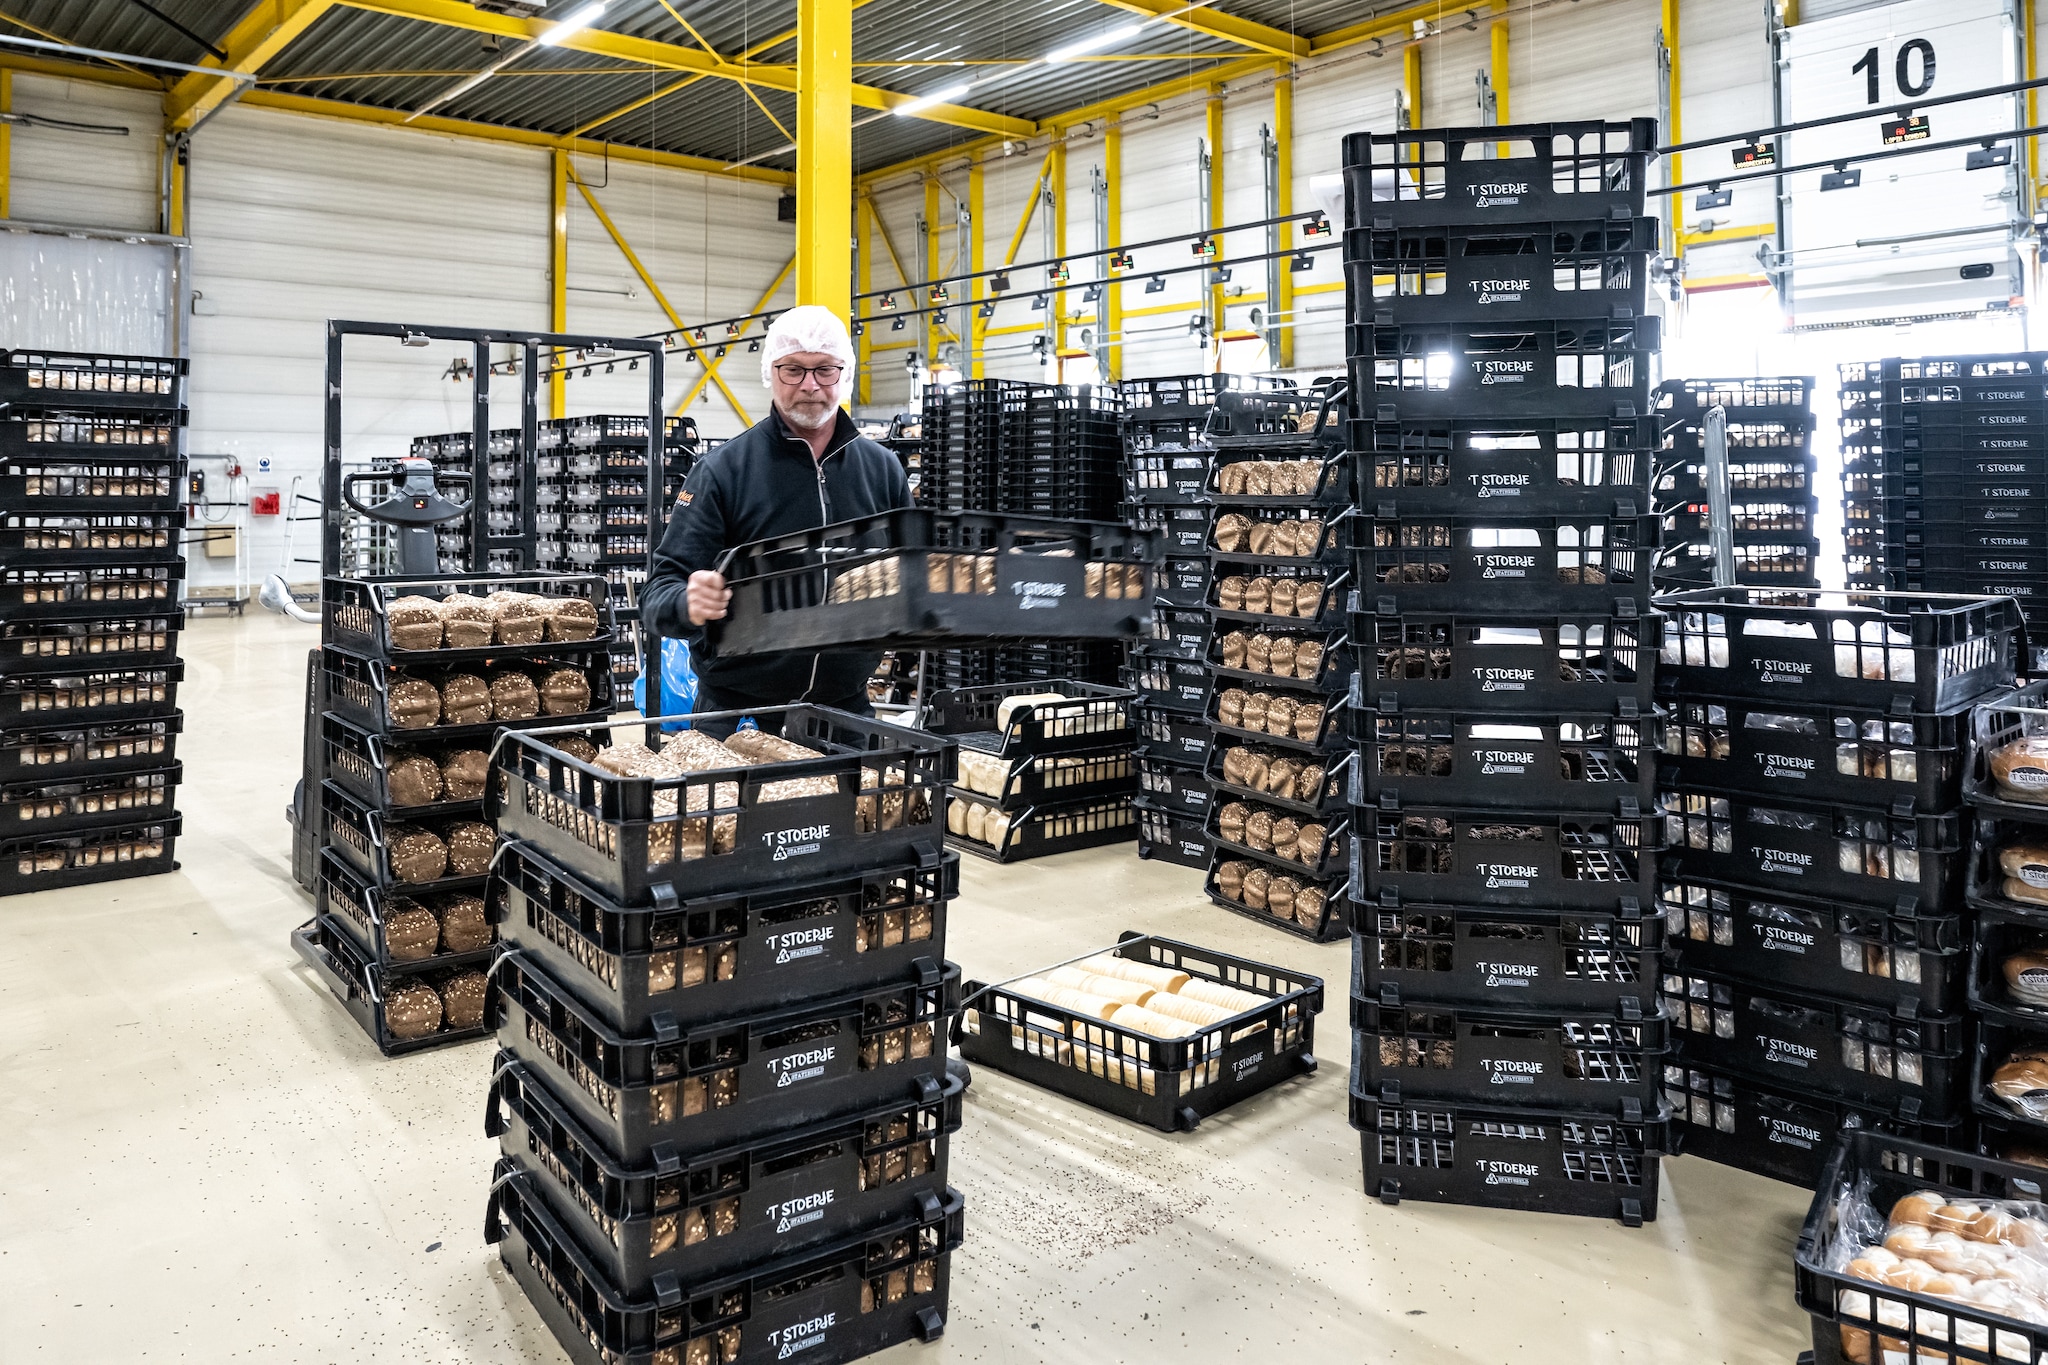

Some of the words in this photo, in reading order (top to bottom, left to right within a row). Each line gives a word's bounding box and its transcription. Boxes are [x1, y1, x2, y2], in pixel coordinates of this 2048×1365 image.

[1852, 38, 1936, 104] 10
[1480, 183, 1528, 195] STOEPJE
[1482, 279, 1531, 291] STOEPJE
[1485, 361, 1533, 372] STOEPJE
[1482, 474, 1530, 485] STOEPJE
[1487, 555, 1535, 567] STOEPJE
[1486, 668, 1535, 680] STOEPJE
[1765, 660, 1812, 673] STOEPJE
[1486, 751, 1534, 763] STOEPJE
[1767, 754, 1815, 770] STOEPJE
[762, 832, 774, 846] 'T
[777, 825, 830, 844] STOEPJE
[1765, 849, 1812, 866] STOEPJE
[1490, 864, 1538, 877] STOEPJE
[766, 935, 778, 950] 'T
[781, 927, 834, 947] STOEPJE
[1766, 927, 1814, 945] STOEPJE
[1490, 963, 1538, 976] STOEPJE
[1770, 1039, 1818, 1059] STOEPJE
[767, 1059, 779, 1073] 'T
[782, 1047, 835, 1070] STOEPJE
[1495, 1060, 1543, 1073] STOEPJE
[1772, 1119, 1821, 1141] STOEPJE
[1490, 1161, 1539, 1176] STOEPJE
[766, 1205, 779, 1219] 'T
[782, 1189, 834, 1216] STOEPJE
[768, 1331, 780, 1346] 'T
[783, 1312, 836, 1341] STOEPJE
